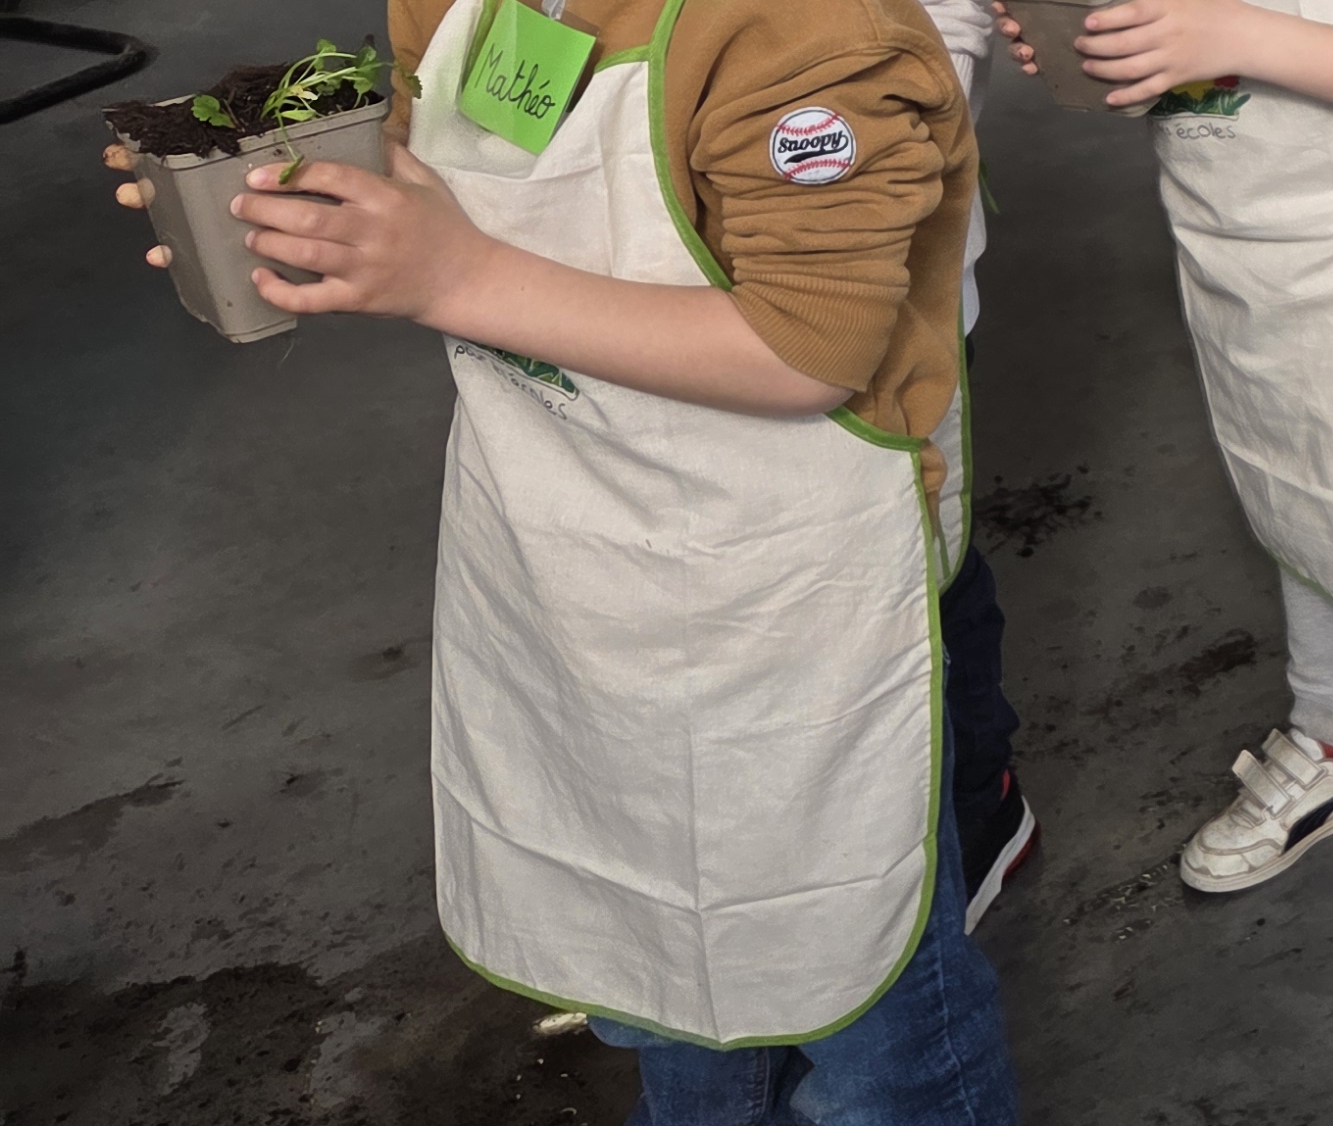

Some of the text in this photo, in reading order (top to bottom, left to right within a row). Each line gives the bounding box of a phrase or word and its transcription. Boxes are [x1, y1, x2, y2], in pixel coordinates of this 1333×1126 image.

[474, 42, 556, 119] Mathéo
[777, 130, 849, 155] Snoopy
[1176, 122, 1236, 140] écoles
